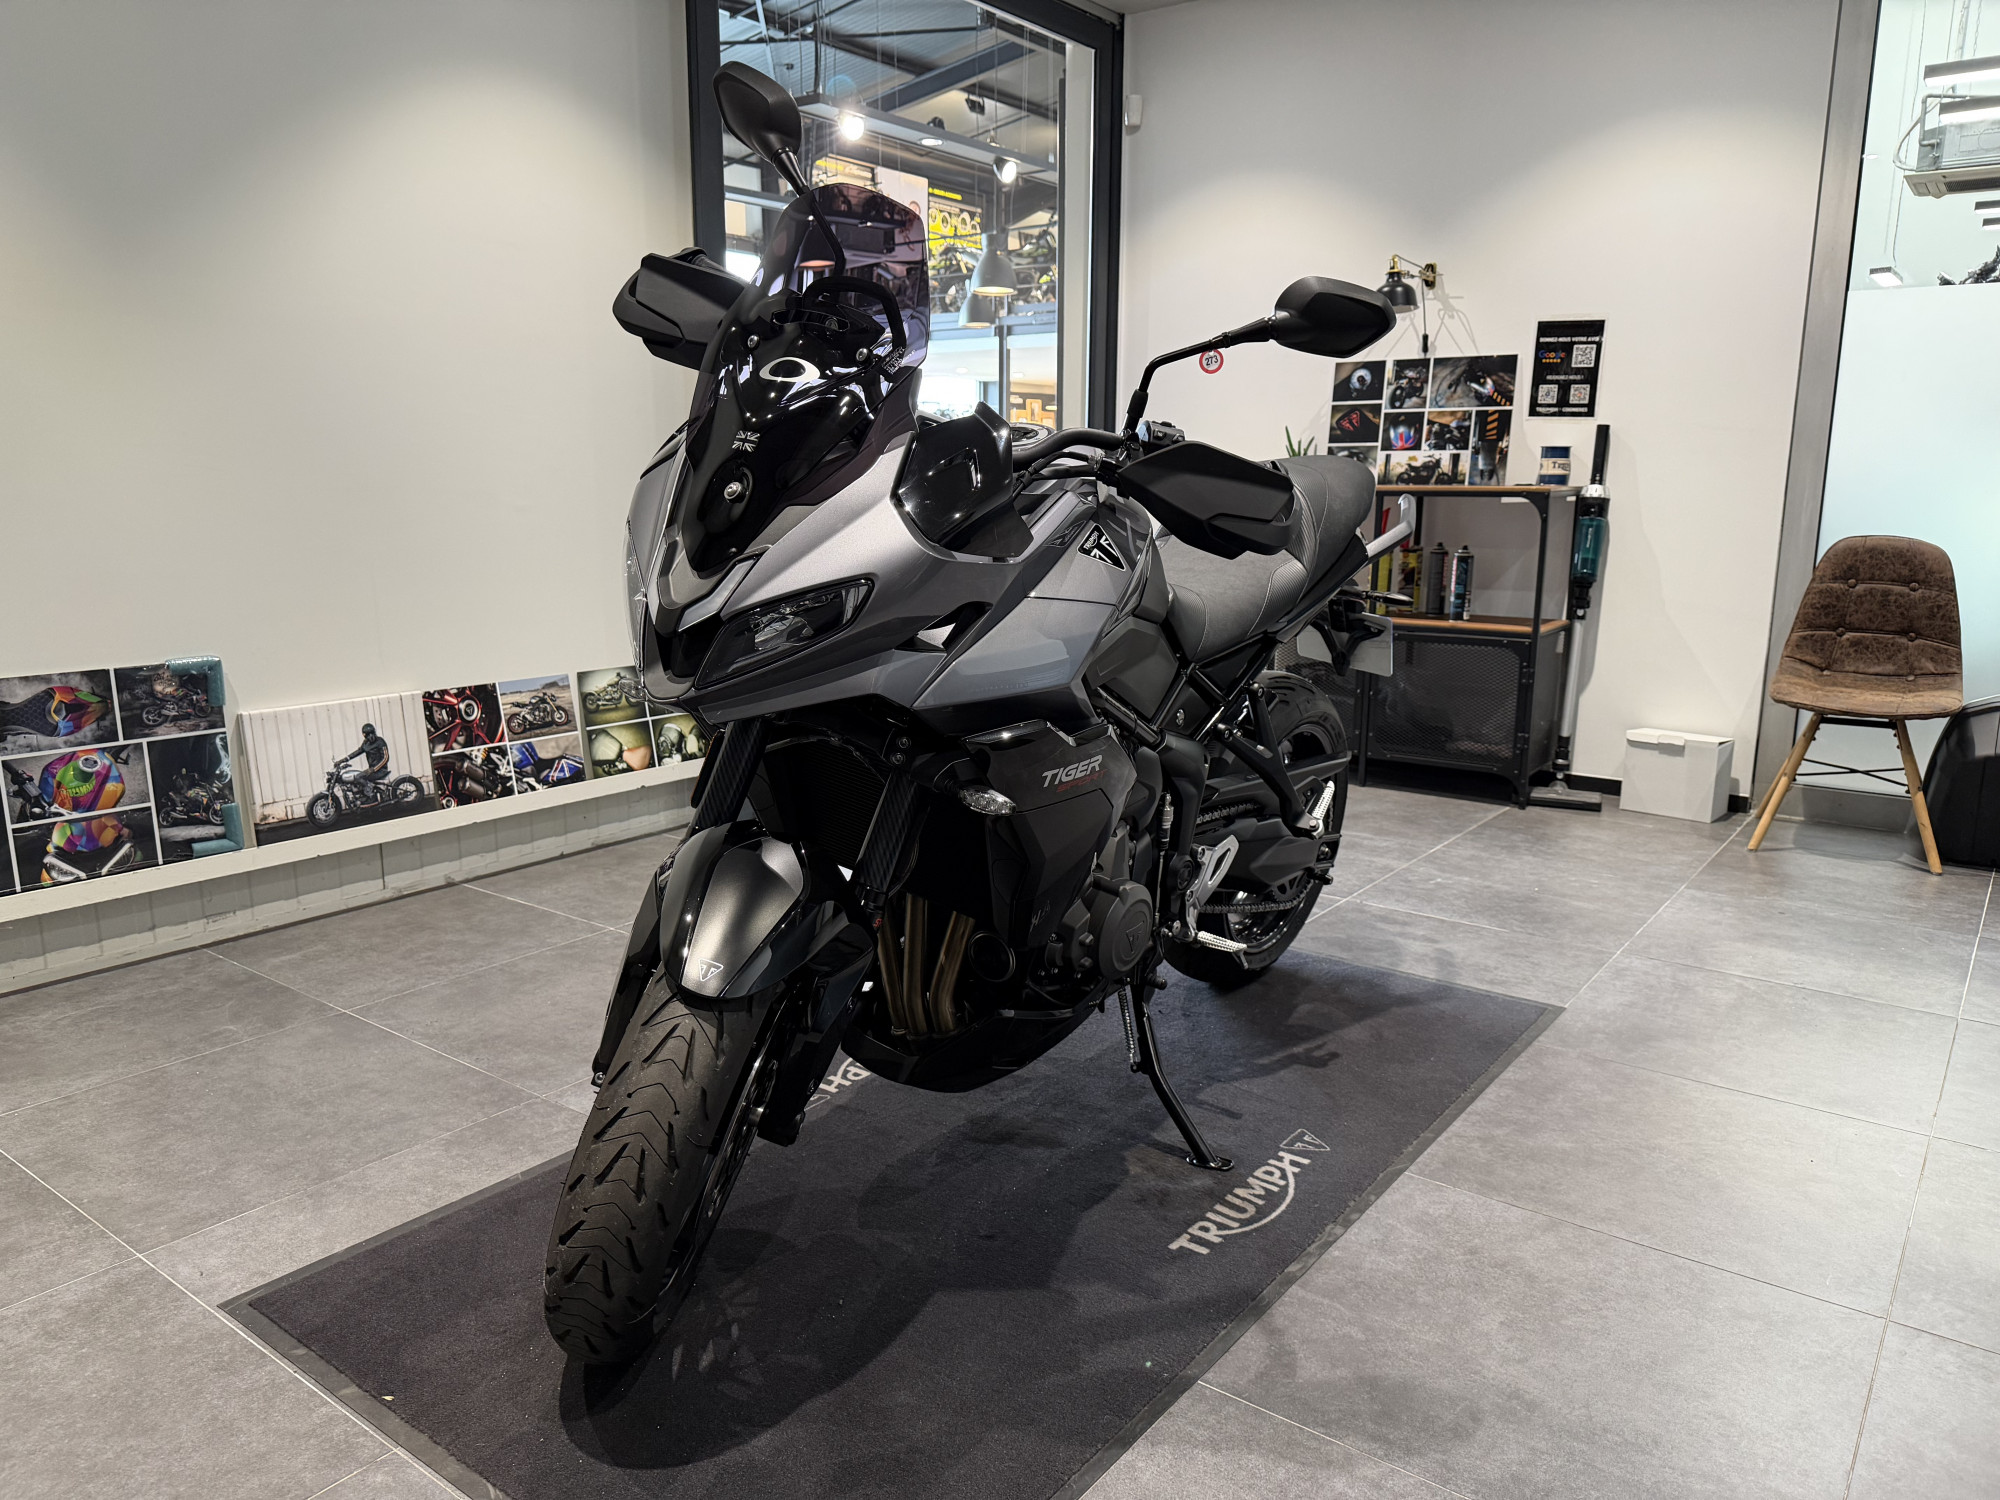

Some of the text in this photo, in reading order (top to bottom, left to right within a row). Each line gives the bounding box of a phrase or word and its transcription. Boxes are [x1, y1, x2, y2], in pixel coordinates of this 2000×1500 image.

[1539, 350, 1566, 359] Google
[1083, 530, 1099, 550] TRIUMPH
[1042, 754, 1103, 788] TIGER
[1056, 769, 1108, 793] SPORT
[1168, 1151, 1311, 1255] TRIUMPH
